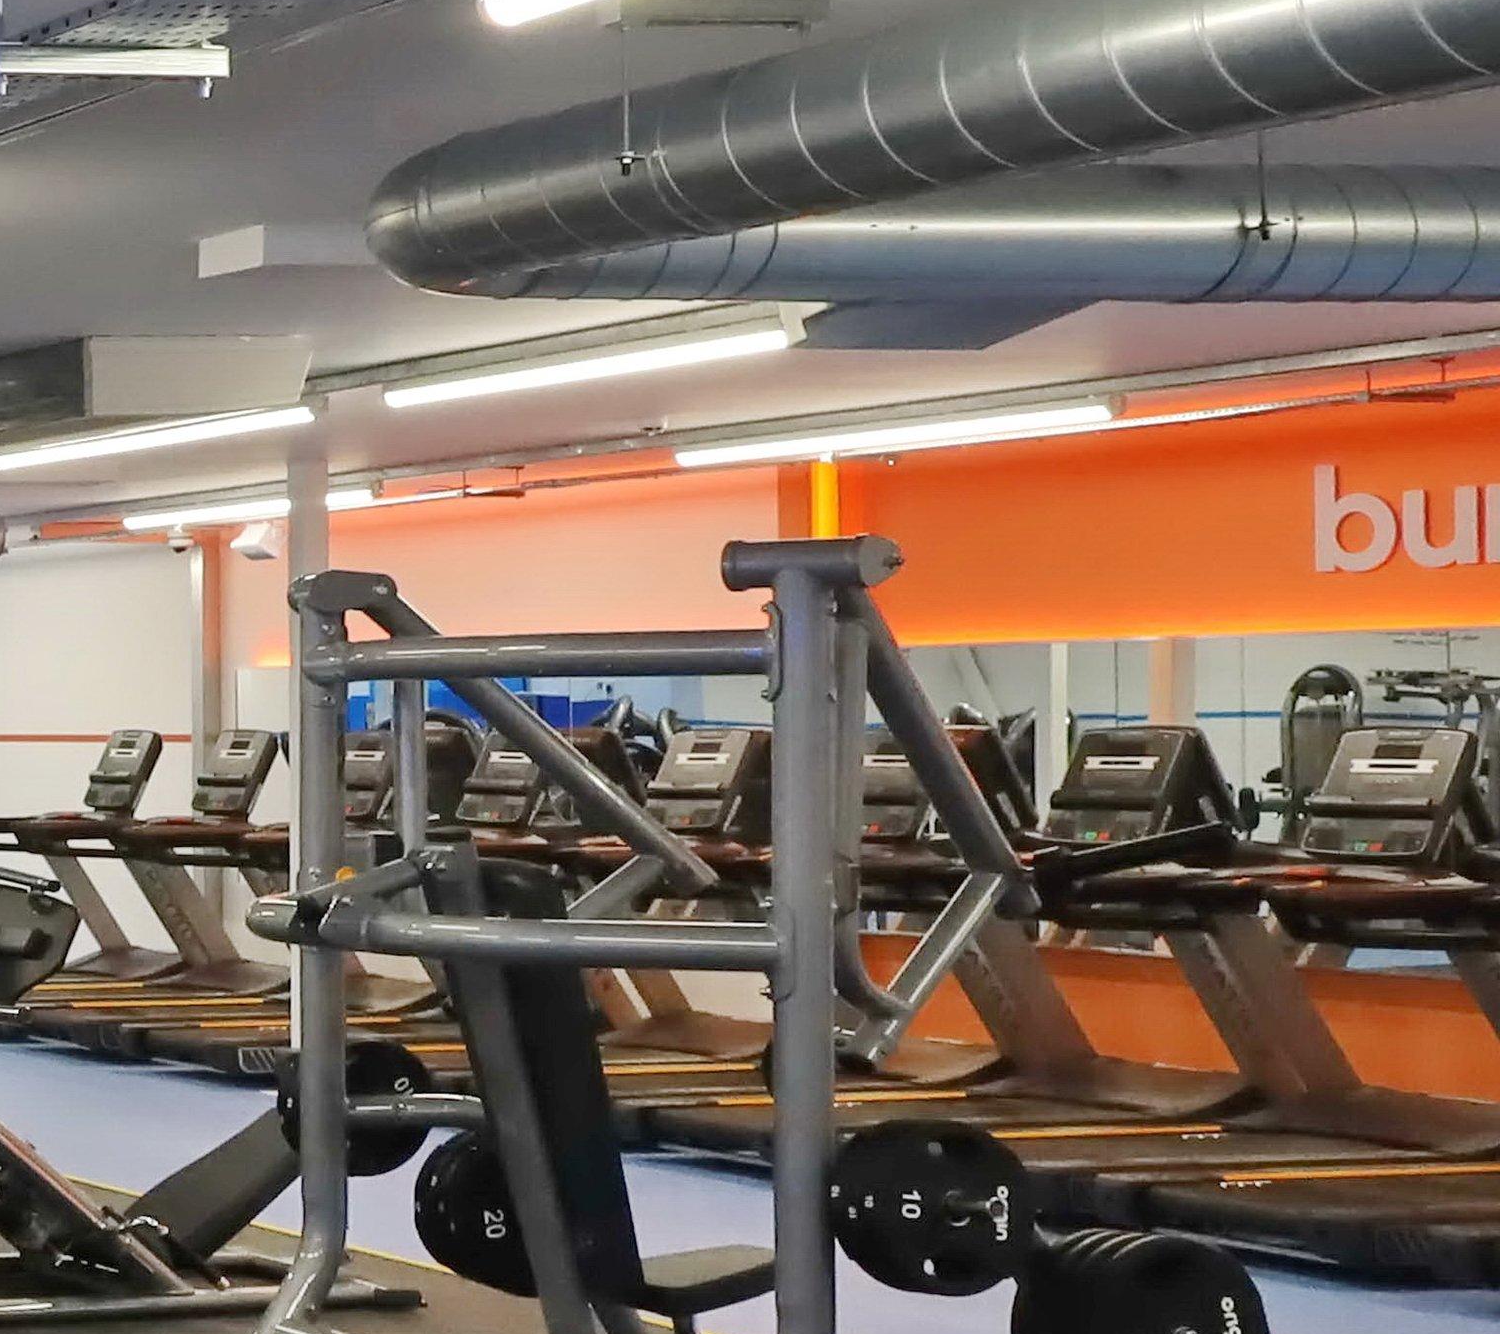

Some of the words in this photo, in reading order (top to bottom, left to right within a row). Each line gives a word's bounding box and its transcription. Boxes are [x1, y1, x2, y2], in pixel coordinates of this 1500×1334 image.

[1314, 465, 1500, 571] bu
[901, 1189, 922, 1220] 10
[483, 1209, 507, 1240] 20
